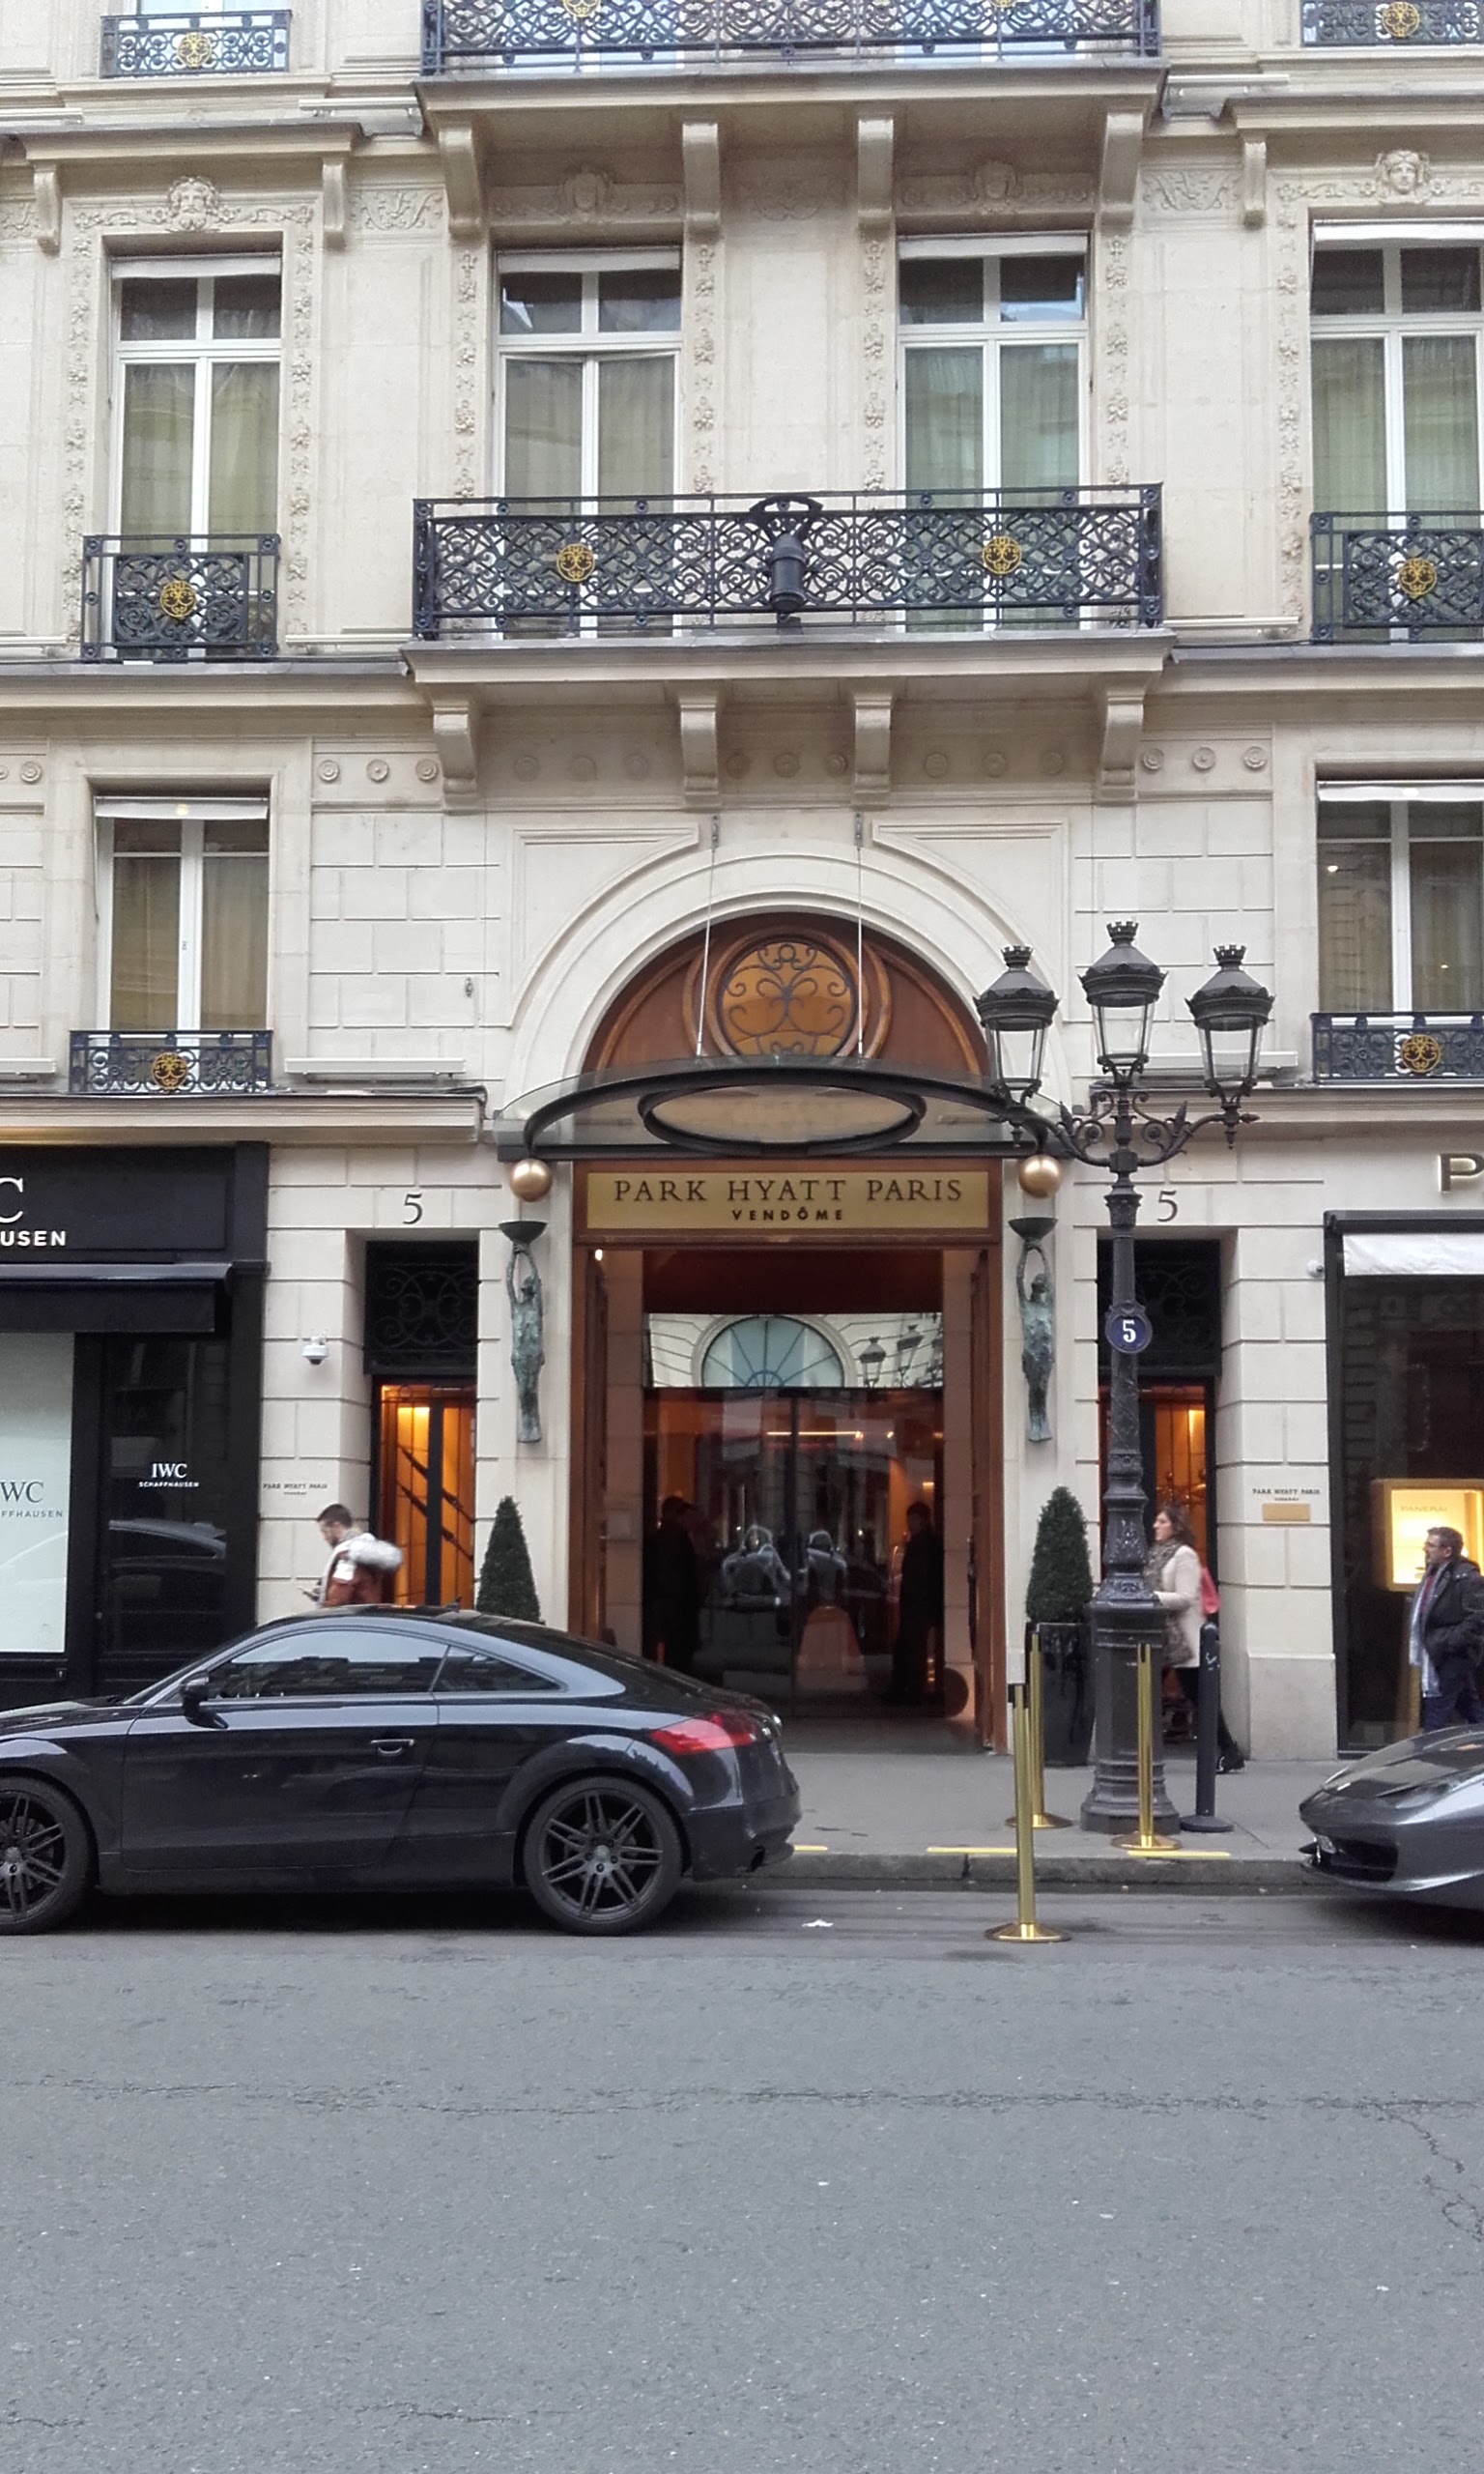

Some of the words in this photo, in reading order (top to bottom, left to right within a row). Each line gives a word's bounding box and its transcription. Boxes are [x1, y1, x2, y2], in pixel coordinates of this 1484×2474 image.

[614, 1179, 707, 1202] PARK
[727, 1179, 846, 1202] HYATT
[866, 1179, 962, 1202] PARIS
[402, 1193, 423, 1225] 5
[731, 1206, 842, 1221] VENDÔME
[1157, 1190, 1179, 1223] 5
[0, 1230, 66, 1247] USEN
[1122, 1318, 1137, 1343] 5
[152, 1463, 187, 1479] IWC
